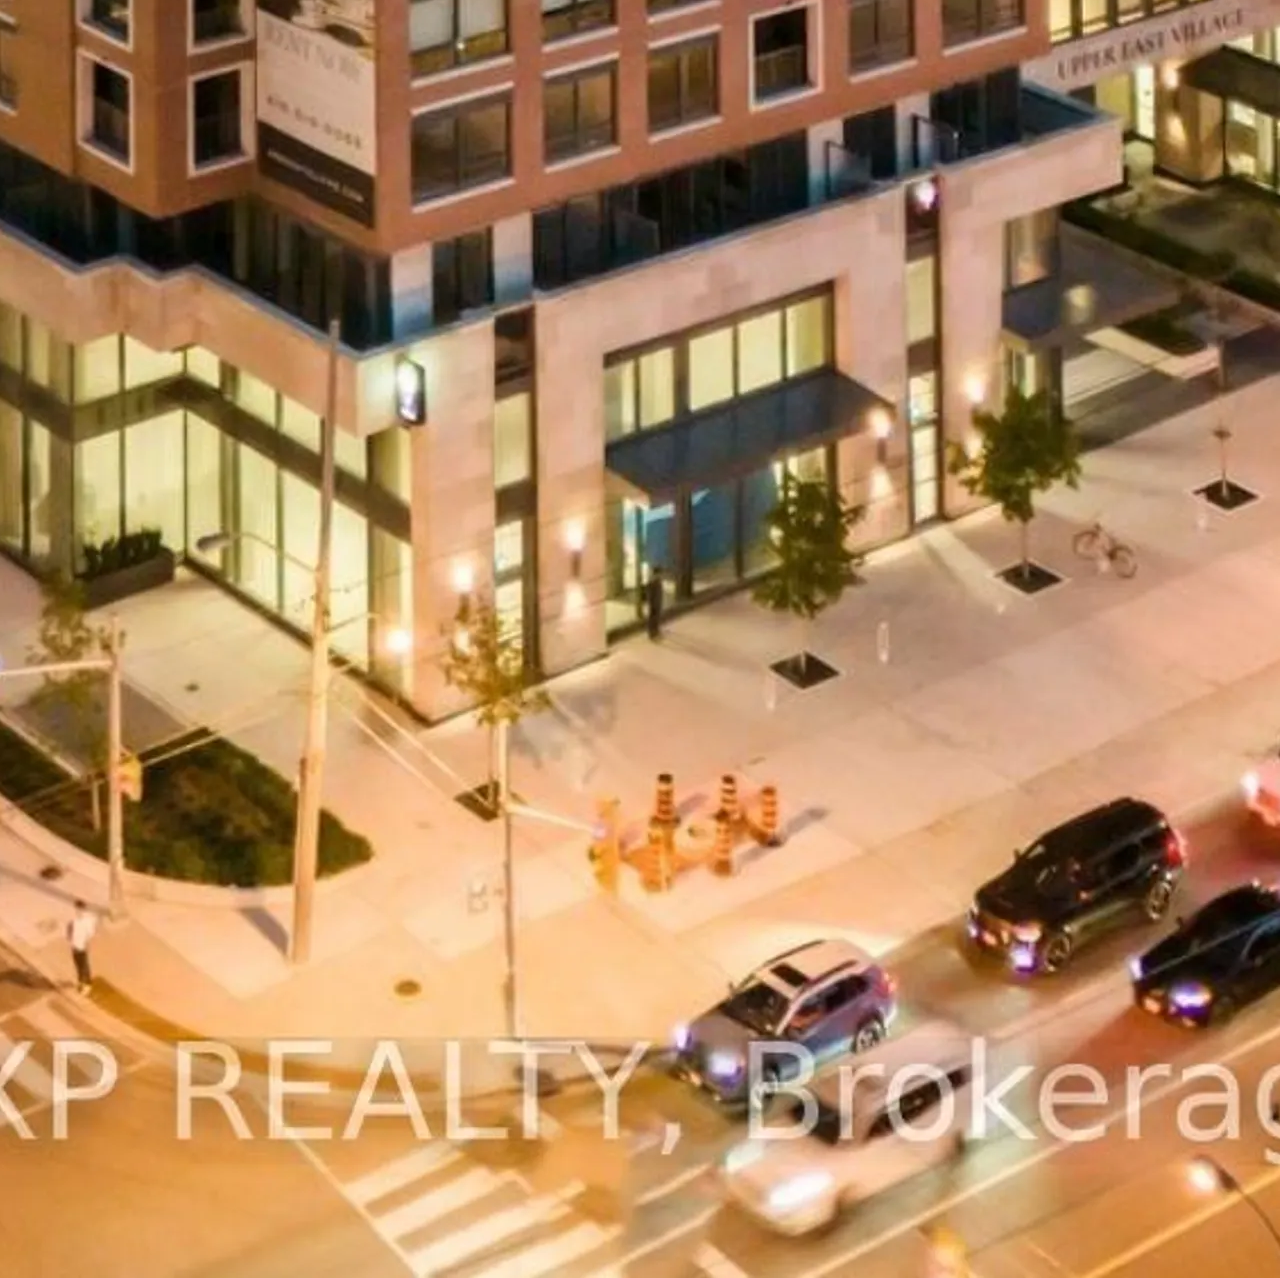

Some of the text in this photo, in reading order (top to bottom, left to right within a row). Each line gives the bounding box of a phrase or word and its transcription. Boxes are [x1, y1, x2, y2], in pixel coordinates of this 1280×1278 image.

[1057, 7, 1245, 81] UPPER EAST VILLAGE
